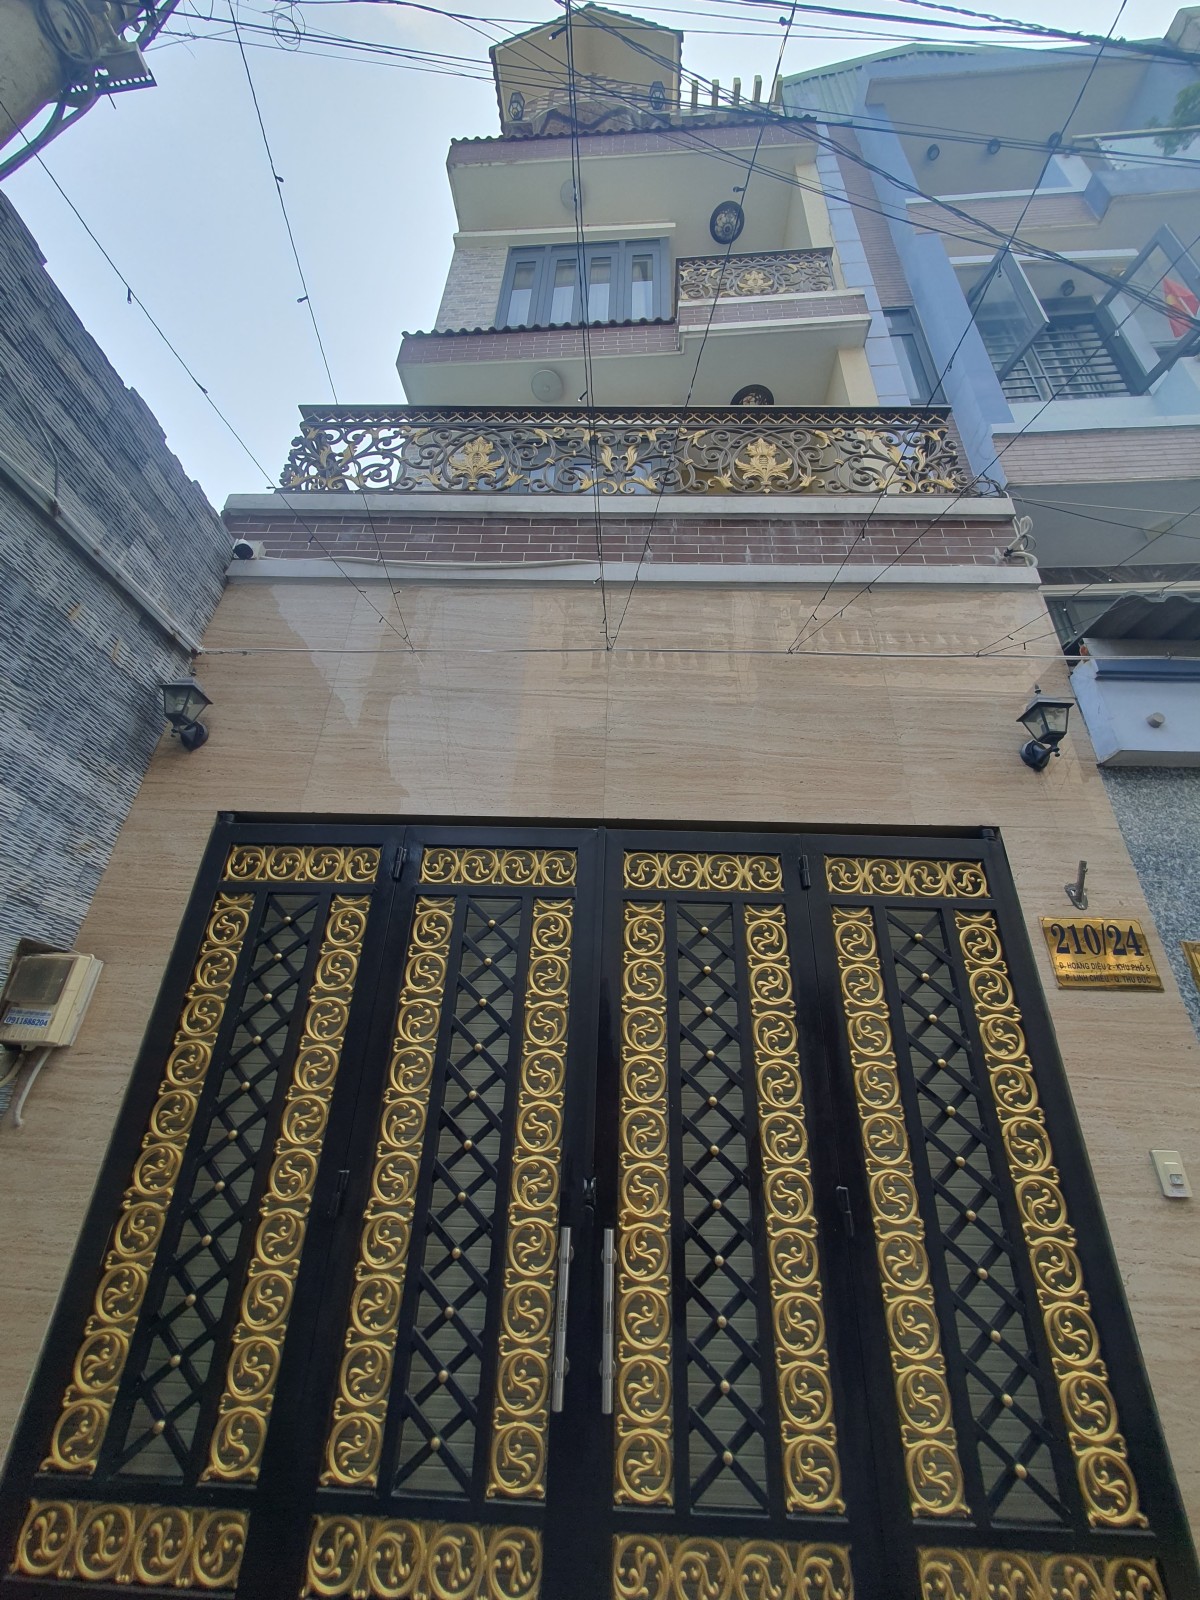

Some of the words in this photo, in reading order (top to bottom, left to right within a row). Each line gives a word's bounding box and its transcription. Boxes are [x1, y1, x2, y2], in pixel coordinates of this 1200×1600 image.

[1050, 923, 1144, 956] 210/24
[1107, 963, 1112, 971] 2
[1145, 964, 1151, 972] 5
